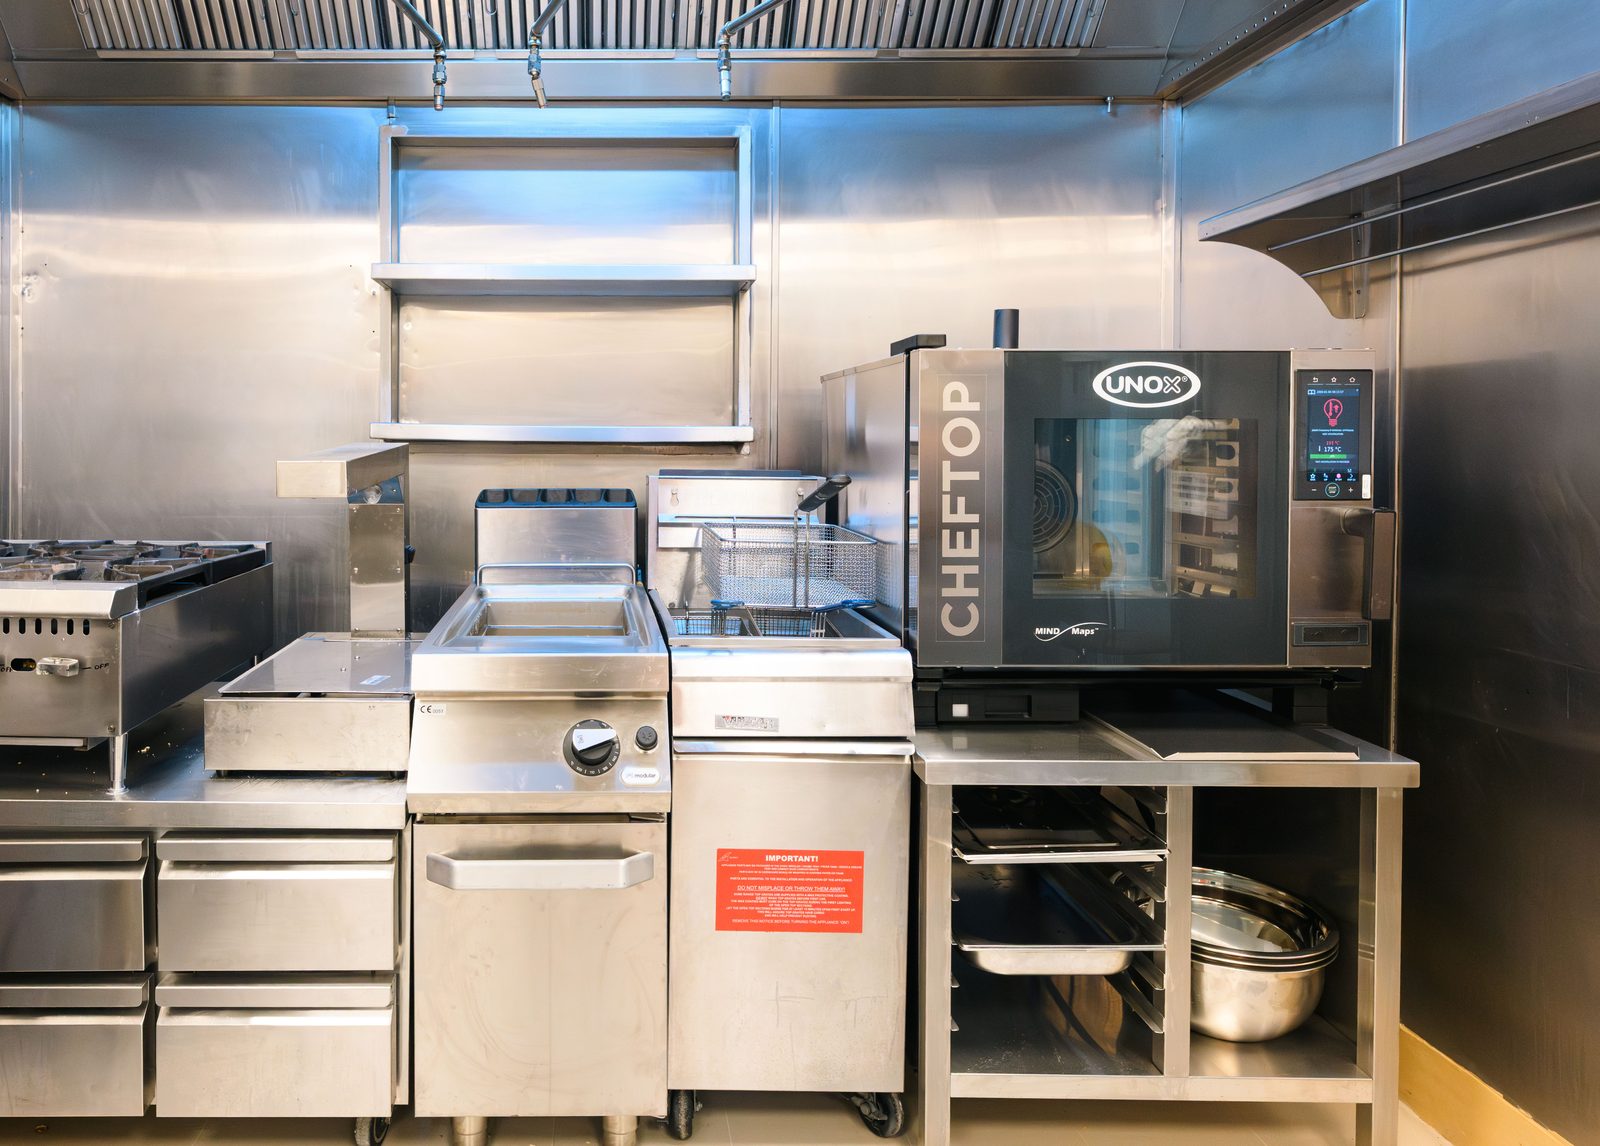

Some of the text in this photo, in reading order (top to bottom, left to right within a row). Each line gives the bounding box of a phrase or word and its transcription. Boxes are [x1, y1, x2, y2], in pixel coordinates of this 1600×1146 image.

[941, 381, 981, 637] CHEFTOP
[1035, 627, 1060, 635] MIND
[94, 662, 110, 670] OFF
